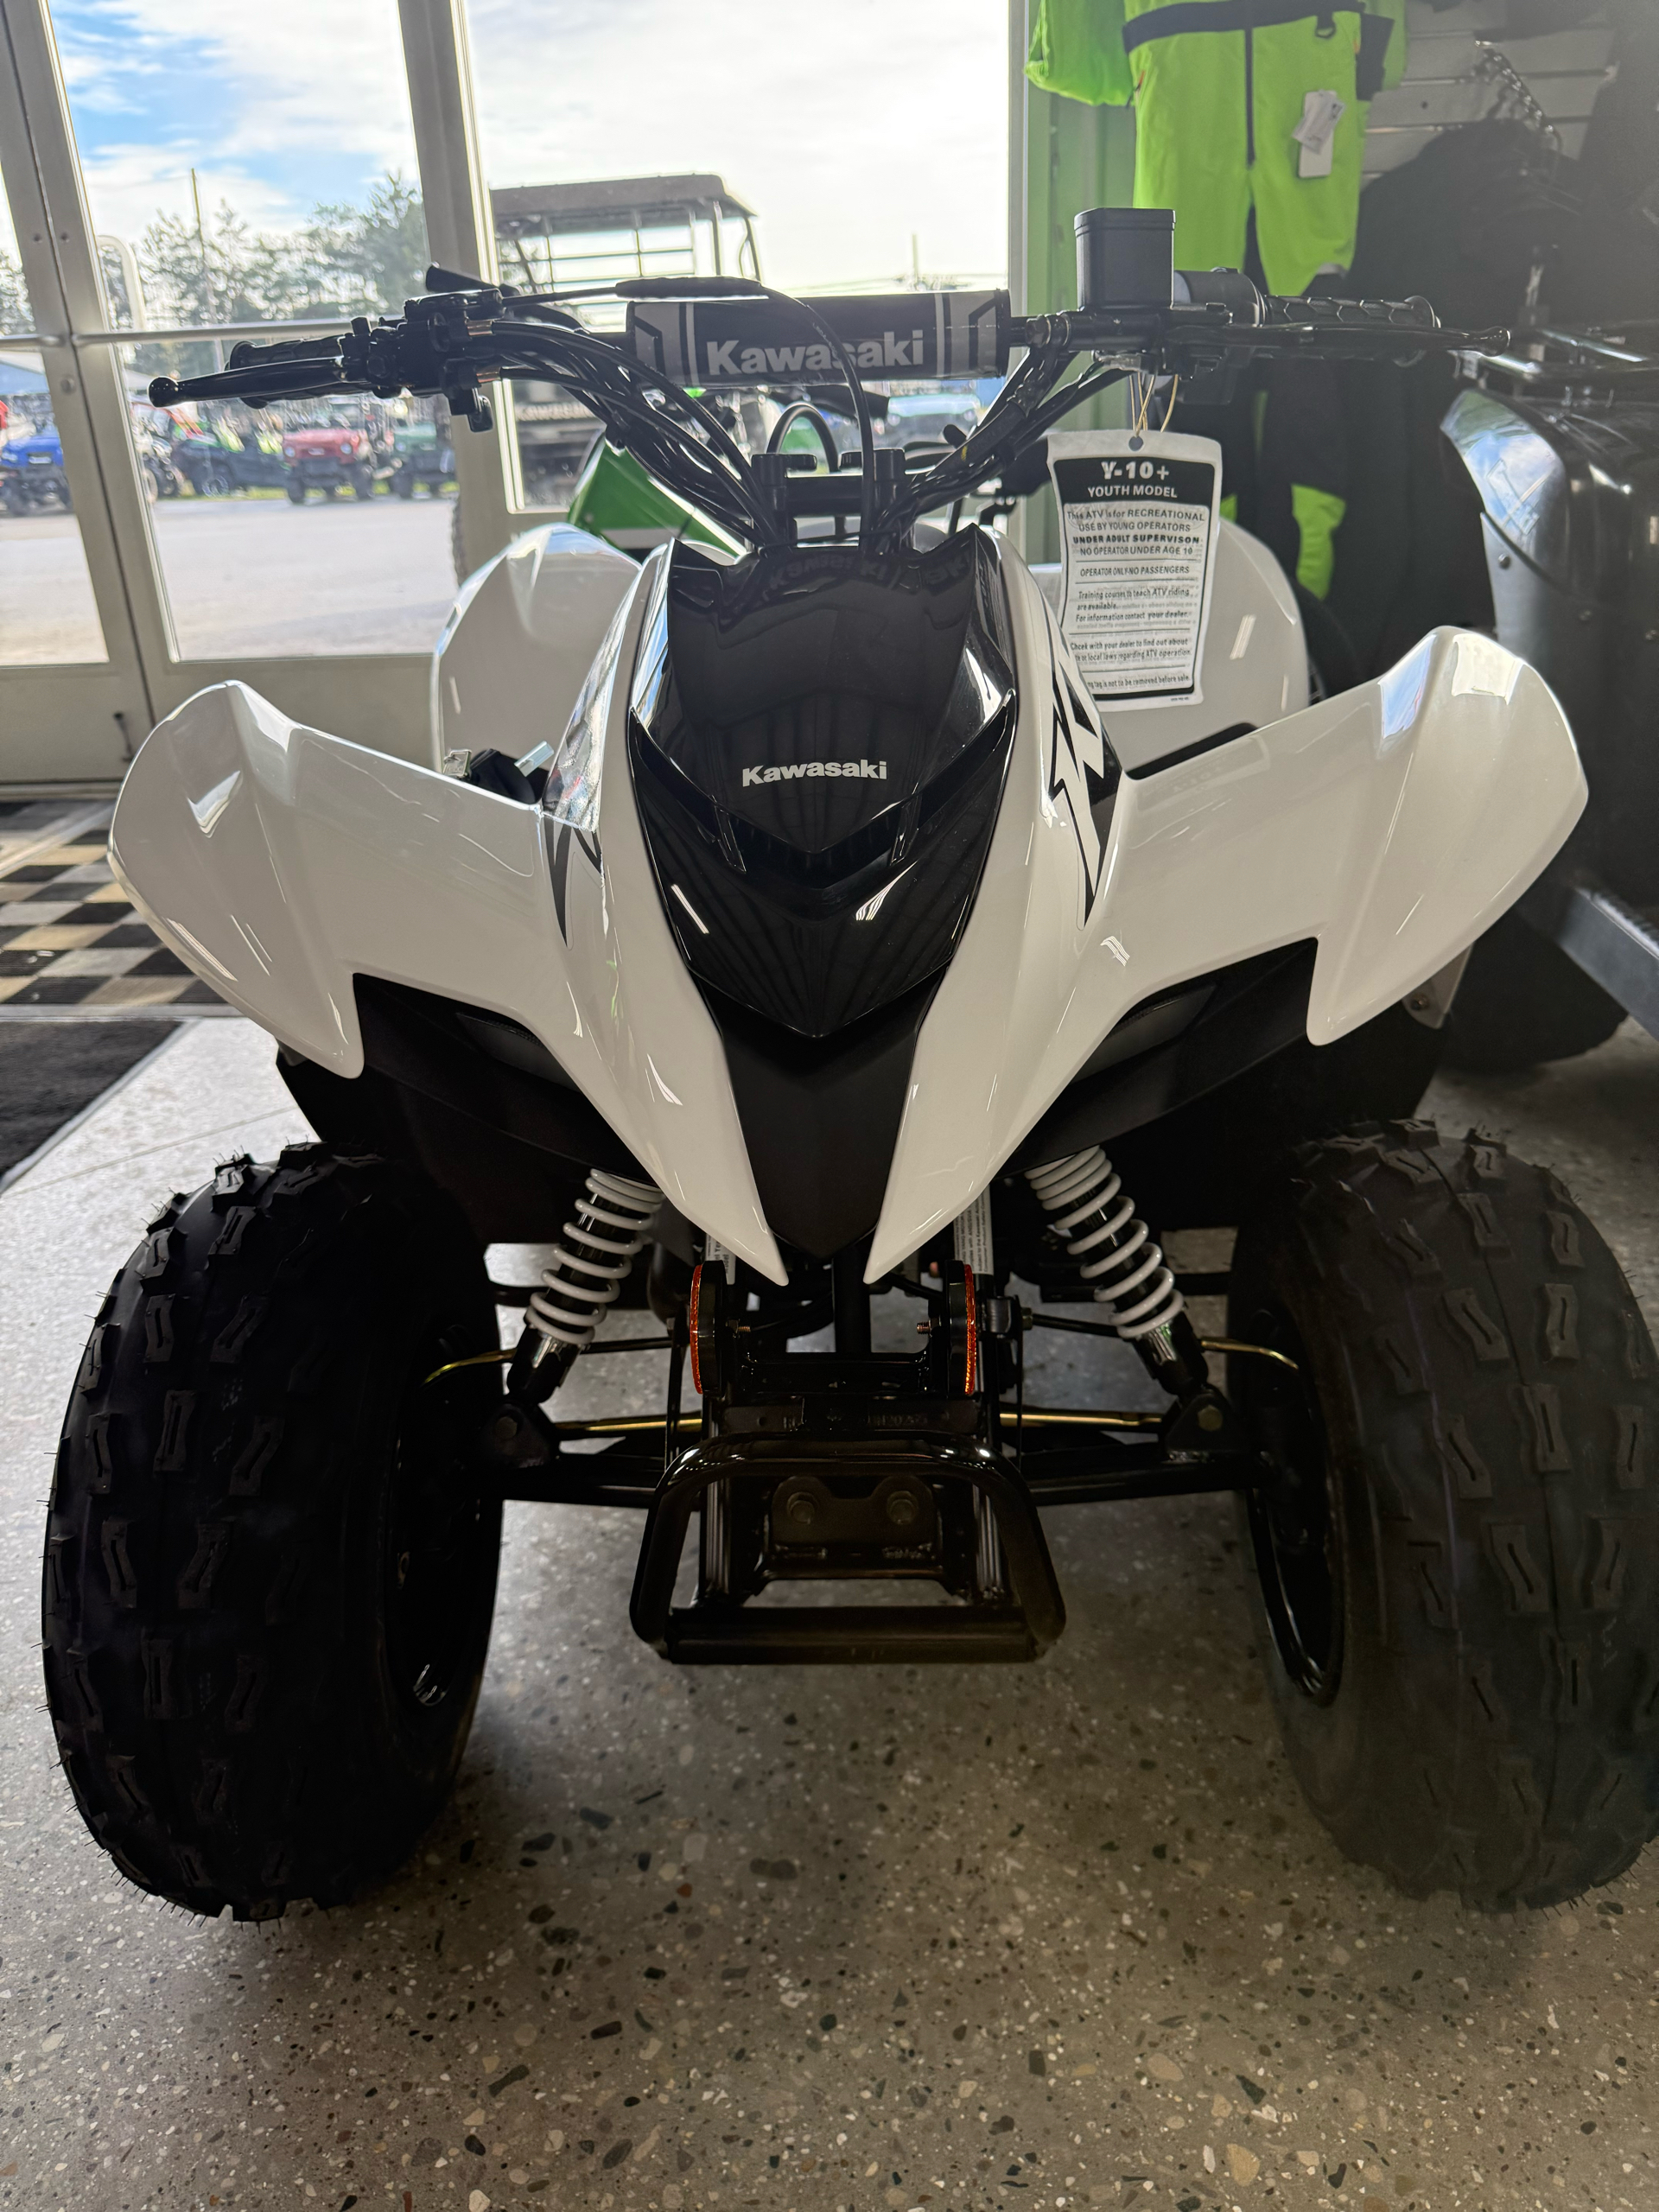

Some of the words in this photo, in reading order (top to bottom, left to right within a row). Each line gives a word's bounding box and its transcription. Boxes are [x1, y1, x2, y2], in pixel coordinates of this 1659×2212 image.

[706, 329, 925, 376] Kawasaki
[1088, 485, 1130, 498] YOUTH
[1133, 485, 1178, 499] MODEL
[1067, 511, 1084, 519] This
[1086, 510, 1103, 519] ATV
[1128, 509, 1205, 521] RECREATIONAL
[1078, 523, 1096, 531] USE
[1097, 522, 1107, 531] BY
[1109, 521, 1135, 530] YOUNG
[1137, 521, 1191, 531] OPERATORS
[1073, 535, 1103, 543] UNDER
[1080, 547, 1092, 556] NO
[1093, 546, 1128, 556] OPERATOR
[1130, 546, 1160, 555] UNDER
[1162, 546, 1180, 555] AGE
[1080, 568, 1112, 576] OPERATOR
[1141, 565, 1190, 575] PASSENGERS
[1078, 591, 1103, 600] Training
[1133, 588, 1150, 597] teach
[1152, 588, 1167, 596] ATV
[1168, 588, 1190, 597] riding
[1087, 613, 1123, 621] information
[1147, 612, 1164, 620] your
[1090, 641, 1103, 650] with
[1104, 642, 1118, 651] your
[1088, 652, 1102, 661] local
[1103, 652, 1116, 660] laws
[1117, 651, 1145, 661] regarding
[1158, 675, 1176, 683] before
[742, 759, 887, 787] Kawasaki
